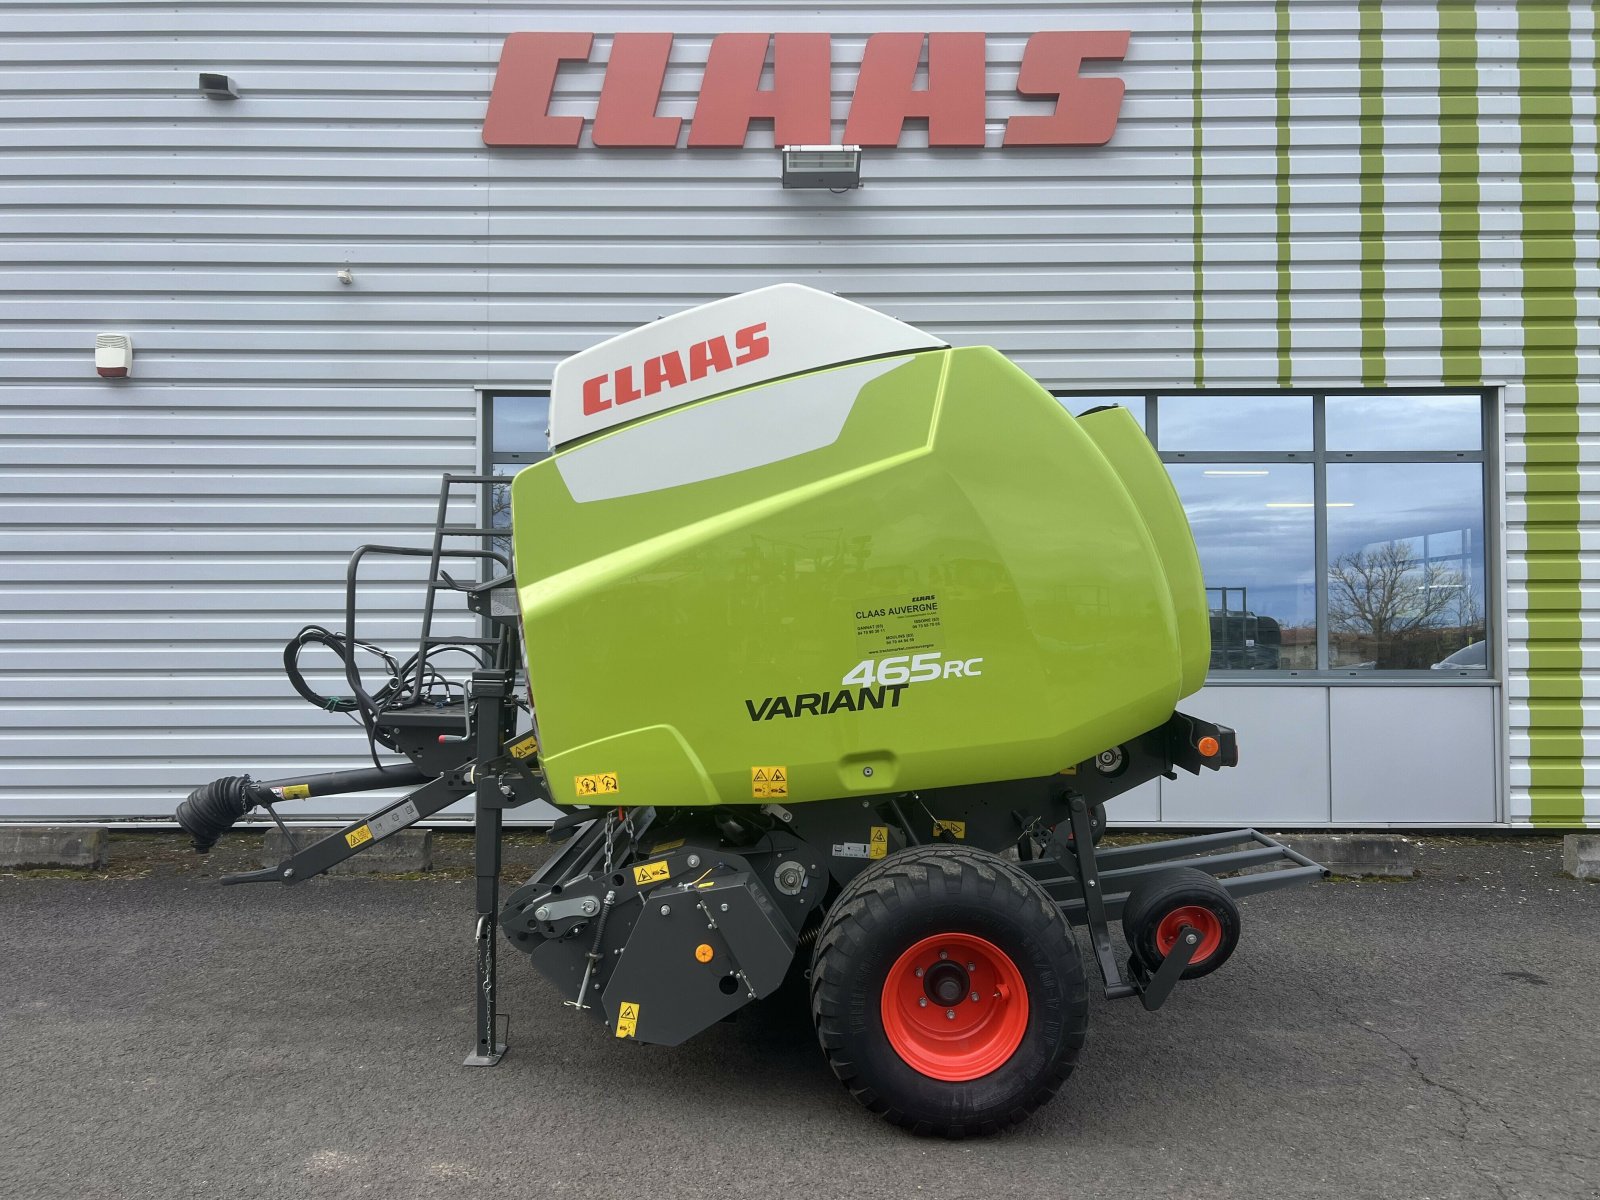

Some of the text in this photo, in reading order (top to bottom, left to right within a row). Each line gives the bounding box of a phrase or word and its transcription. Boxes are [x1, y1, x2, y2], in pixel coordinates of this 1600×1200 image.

[482, 30, 1131, 148] CLAAS
[583, 322, 769, 416] CLAAS
[856, 609, 885, 619] CLAAS
[888, 602, 938, 615] AUVERGNE
[745, 683, 909, 722] VARIANT
